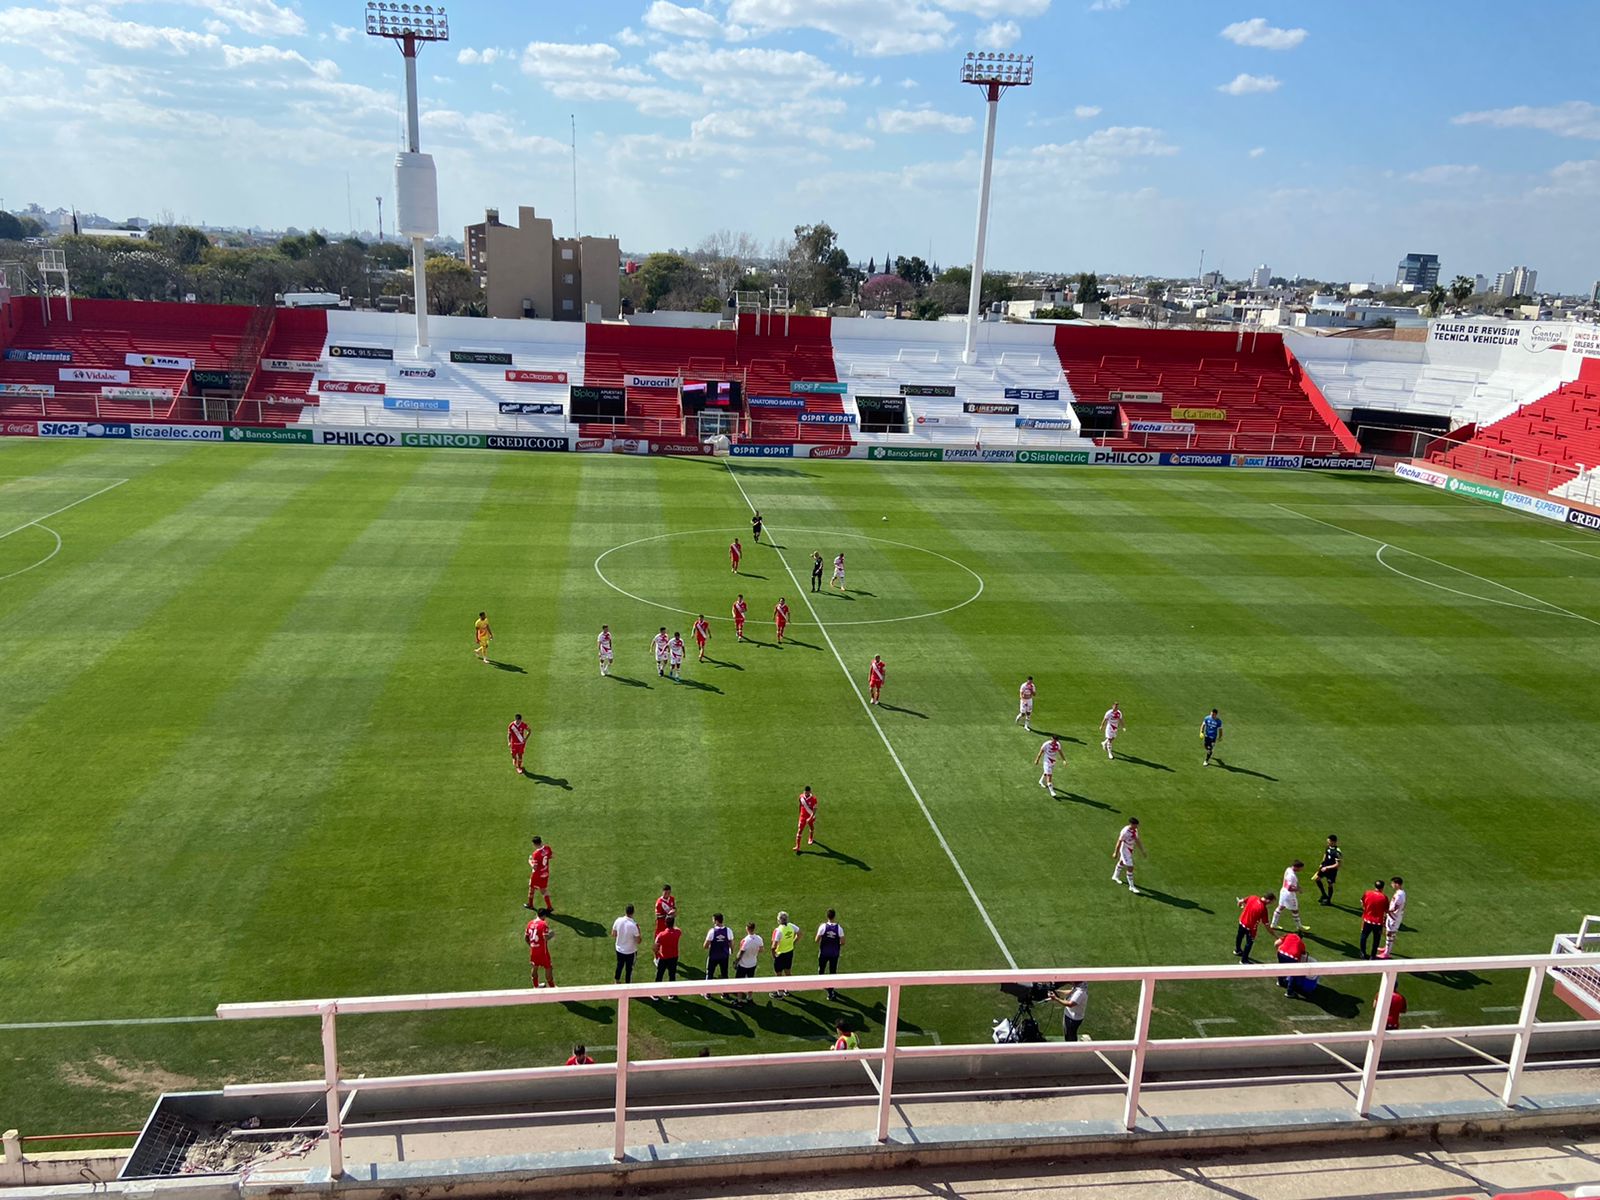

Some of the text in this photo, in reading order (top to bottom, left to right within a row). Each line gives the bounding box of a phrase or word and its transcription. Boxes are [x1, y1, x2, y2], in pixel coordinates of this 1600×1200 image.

[1436, 323, 1521, 337] TALLER DE REVISION
[1532, 325, 1562, 338] Control
[1434, 332, 1519, 346] TECNICA VEHICULAR
[27, 351, 71, 362] Suplementos
[86, 371, 118, 380] Vidalac
[633, 377, 670, 387] Duracril
[1020, 390, 1043, 399] STE
[401, 400, 439, 410] Gigared
[106, 426, 126, 435] LED
[133, 425, 222, 439] sicaelec.com
[246, 430, 307, 440] Banco Santa Fe
[323, 431, 391, 446] PHILCO
[405, 434, 481, 447] GENROD
[487, 436, 564, 449] CREDICOOP
[733, 447, 760, 455] OSPAT
[764, 447, 790, 455] OSPAT
[887, 450, 908, 458] Banco
[909, 451, 929, 459] Santa
[945, 449, 978, 459] EXPERTA
[982, 450, 1015, 460] EXPERTA
[1030, 452, 1086, 463] Sistelectric
[1094, 453, 1148, 464] PHILCO
[1180, 456, 1223, 464] CETROGAR
[1266, 456, 1300, 468] Hidro3
[1303, 458, 1372, 468] POWERADE
[1459, 482, 1500, 499] Banco Santa Fe
[1504, 491, 1532, 507] EXPERTA
[1535, 499, 1565, 516] EXPERTA
[1569, 510, 1600, 529] CRED
